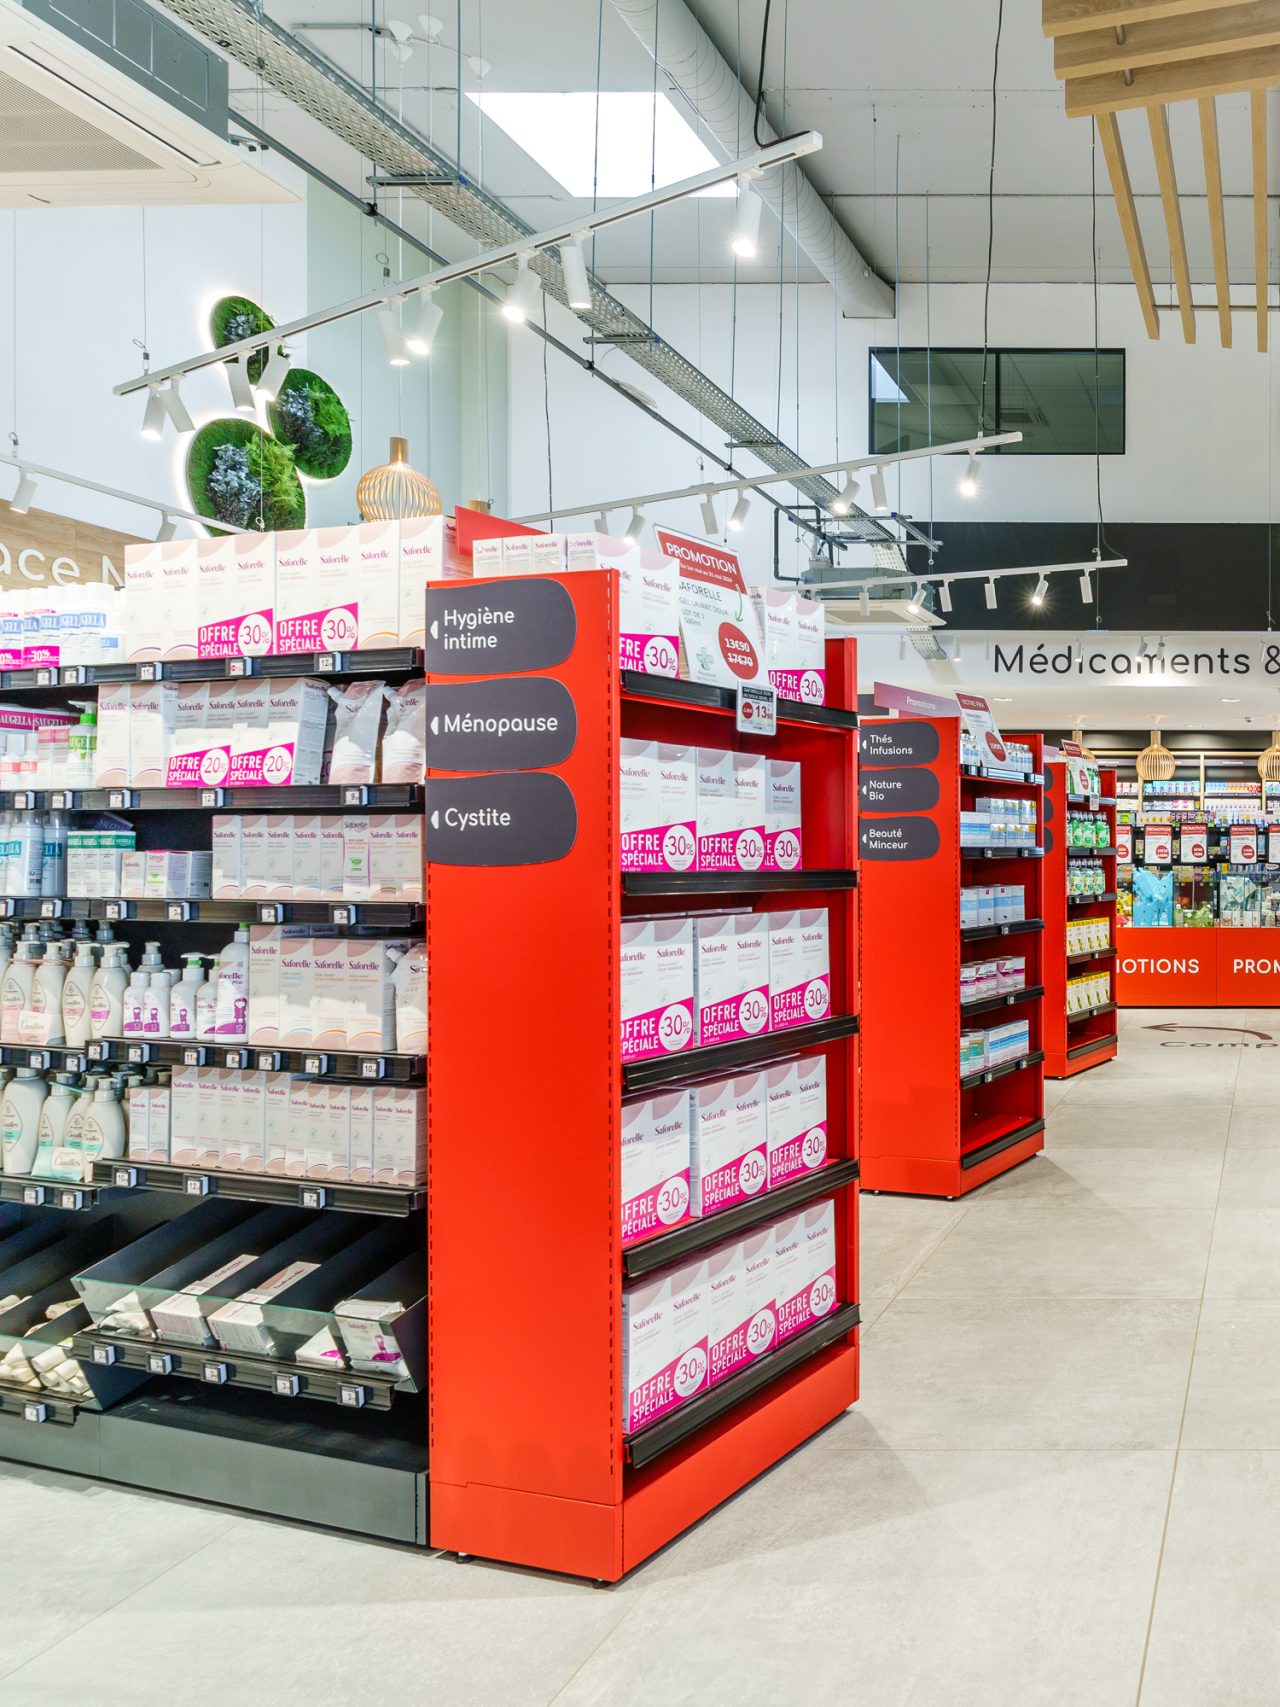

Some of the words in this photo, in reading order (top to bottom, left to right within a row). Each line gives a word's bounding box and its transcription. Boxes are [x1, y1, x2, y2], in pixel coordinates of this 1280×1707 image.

[666, 542, 738, 575] PROMOTION
[642, 575, 672, 594] Saforelle
[679, 581, 722, 602] AFORELLE
[279, 618, 319, 638] OFFRE
[443, 606, 515, 631] Hygiène
[199, 624, 236, 643] OFFRE
[239, 623, 270, 645] -30%
[322, 617, 356, 640] -30%
[199, 640, 239, 656] SPÉCIALE
[279, 635, 322, 652] SPÉCIALE
[443, 633, 498, 650] intime
[723, 637, 750, 652] 13€90
[645, 645, 677, 671] -30%
[993, 643, 1250, 676] Médicaments
[769, 671, 798, 690] OFFRE
[801, 678, 824, 699] -30%
[906, 696, 937, 710] Promotions
[0, 713, 32, 727] AUGELLA
[443, 713, 559, 737] Ménopause
[869, 734, 893, 744] Thés
[869, 746, 913, 755] Infusions
[169, 756, 200, 770] OFFRE
[202, 756, 227, 774] -20%
[230, 755, 262, 769] OFFRE
[264, 755, 291, 773] -20%
[168, 768, 201, 781] SPÉCIALE
[229, 767, 263, 781] SPÉCIALE
[660, 770, 689, 782] Saforelle
[772, 783, 796, 793] Saforelle
[869, 780, 902, 789] Nature
[869, 791, 885, 801] Bio
[444, 808, 512, 832] Cystite
[622, 833, 660, 851] OFFRE
[869, 828, 902, 838] Beauté
[664, 834, 694, 856] -30%
[700, 837, 734, 853] OFFRE
[737, 838, 763, 858] -30%
[775, 839, 800, 858] -30%
[869, 840, 908, 850] Minceur
[621, 851, 664, 866] SPÉCIALE
[700, 854, 737, 867] SPÉCIALE
[737, 938, 762, 950] Saforelle
[801, 931, 824, 943] Saforelle
[656, 946, 686, 960] Saforelle
[701, 942, 729, 955] Saforelle
[281, 958, 312, 969] Saforelle
[314, 959, 345, 970] Saforelle
[348, 960, 380, 971] Saforelle
[1116, 958, 1200, 975] OTIONS
[773, 991, 803, 1010] OFFRE
[805, 986, 829, 1007] -30%
[703, 1002, 737, 1024] OFFRE
[740, 999, 767, 1020] -30%
[773, 1006, 805, 1024] SPÉCIALE
[659, 1014, 691, 1039] -30%
[702, 1020, 740, 1038] SPÉCIALE
[620, 1032, 659, 1056] PÉCIALE
[701, 1108, 727, 1123] Saforelle
[654, 1120, 683, 1136] Saforelle
[772, 1143, 801, 1166] OFFRE
[802, 1136, 826, 1156] -30%
[740, 1159, 766, 1182] -30%
[772, 1158, 803, 1178] SPÉCIALE
[704, 1168, 737, 1192] OFFRE
[658, 1186, 688, 1212] -30%
[704, 1187, 740, 1207] SPÉCIALE
[621, 1213, 657, 1238] PÉCIALE
[806, 1225, 829, 1241] Saforelle
[710, 1274, 737, 1292] Saforelle
[810, 1281, 835, 1305] -30%
[778, 1293, 808, 1320] OFFRE
[632, 1310, 663, 1331] Saforelle
[748, 1314, 775, 1341] -30%
[778, 1309, 811, 1335] SPÉCIALE
[712, 1331, 745, 1361] OFFRE
[711, 1345, 747, 1375] SPÉCIALE
[675, 1357, 706, 1385] -30%
[633, 1369, 671, 1406] OFFRE
[632, 1390, 674, 1423] SPÉCIALE
